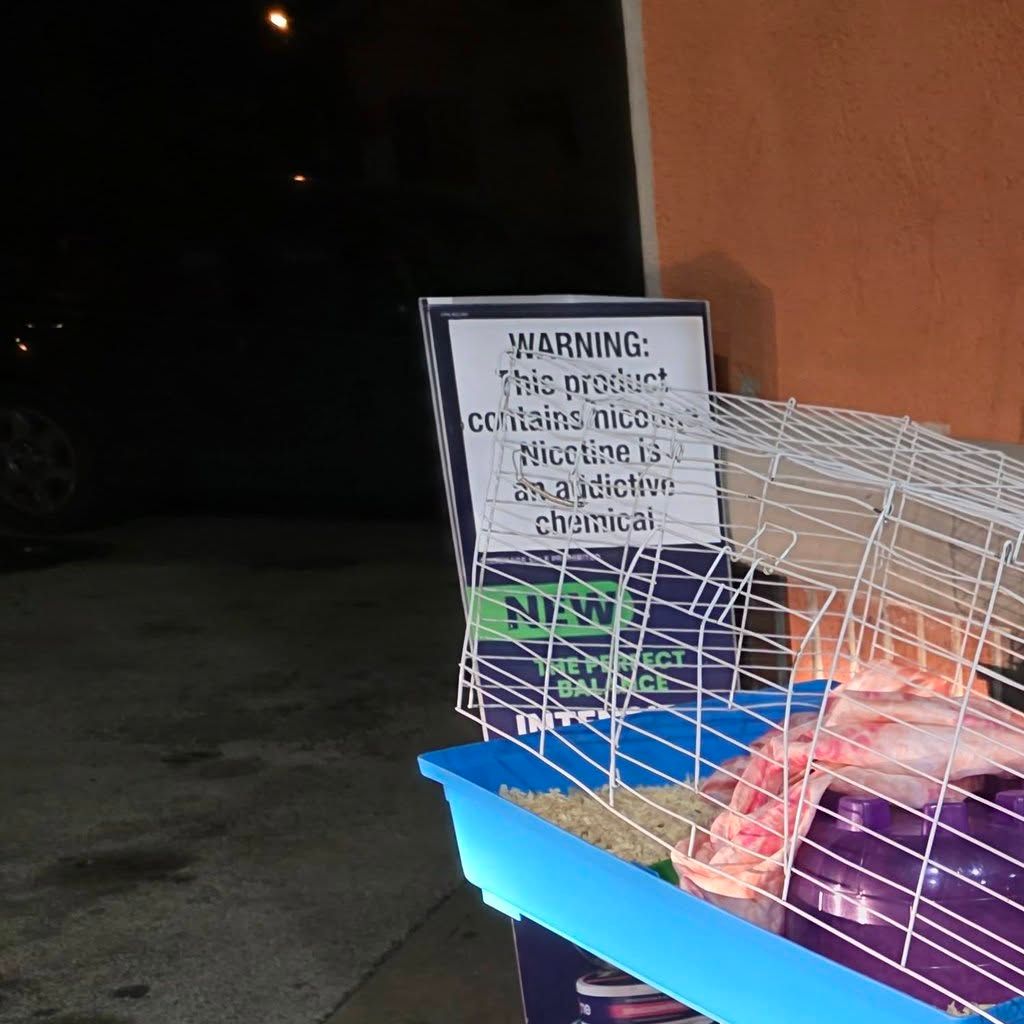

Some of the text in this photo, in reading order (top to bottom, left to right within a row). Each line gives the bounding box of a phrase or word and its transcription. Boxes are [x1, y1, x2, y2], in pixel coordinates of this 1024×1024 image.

[509, 331, 649, 359] WARNING:
[564, 368, 669, 401] product
[520, 437, 662, 467] Nicotine is
[514, 480, 546, 502] an
[505, 591, 619, 631] NEW
[533, 656, 580, 676] THE
[557, 673, 669, 699] BALNCE
